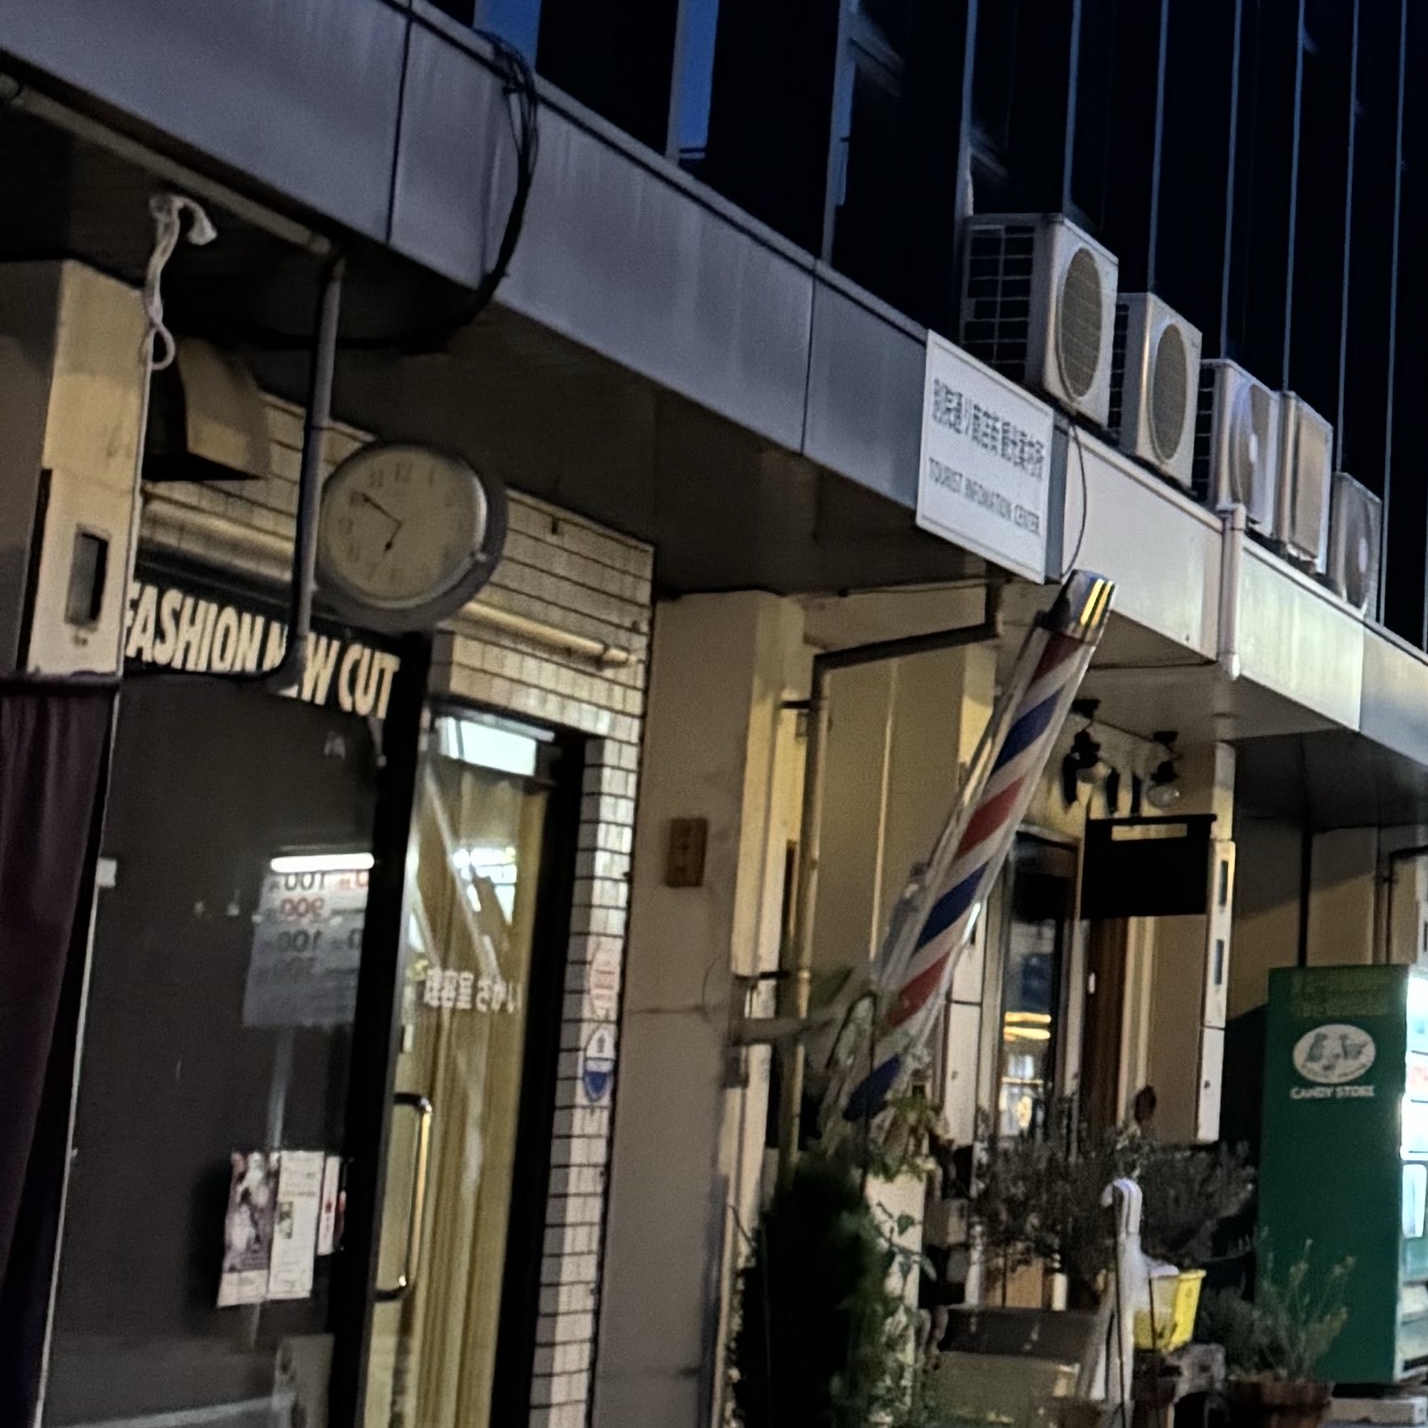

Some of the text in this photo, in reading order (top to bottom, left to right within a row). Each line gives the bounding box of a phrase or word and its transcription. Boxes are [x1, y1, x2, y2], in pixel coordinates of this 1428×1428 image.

[125, 581, 401, 720] FASHION NW CUT
